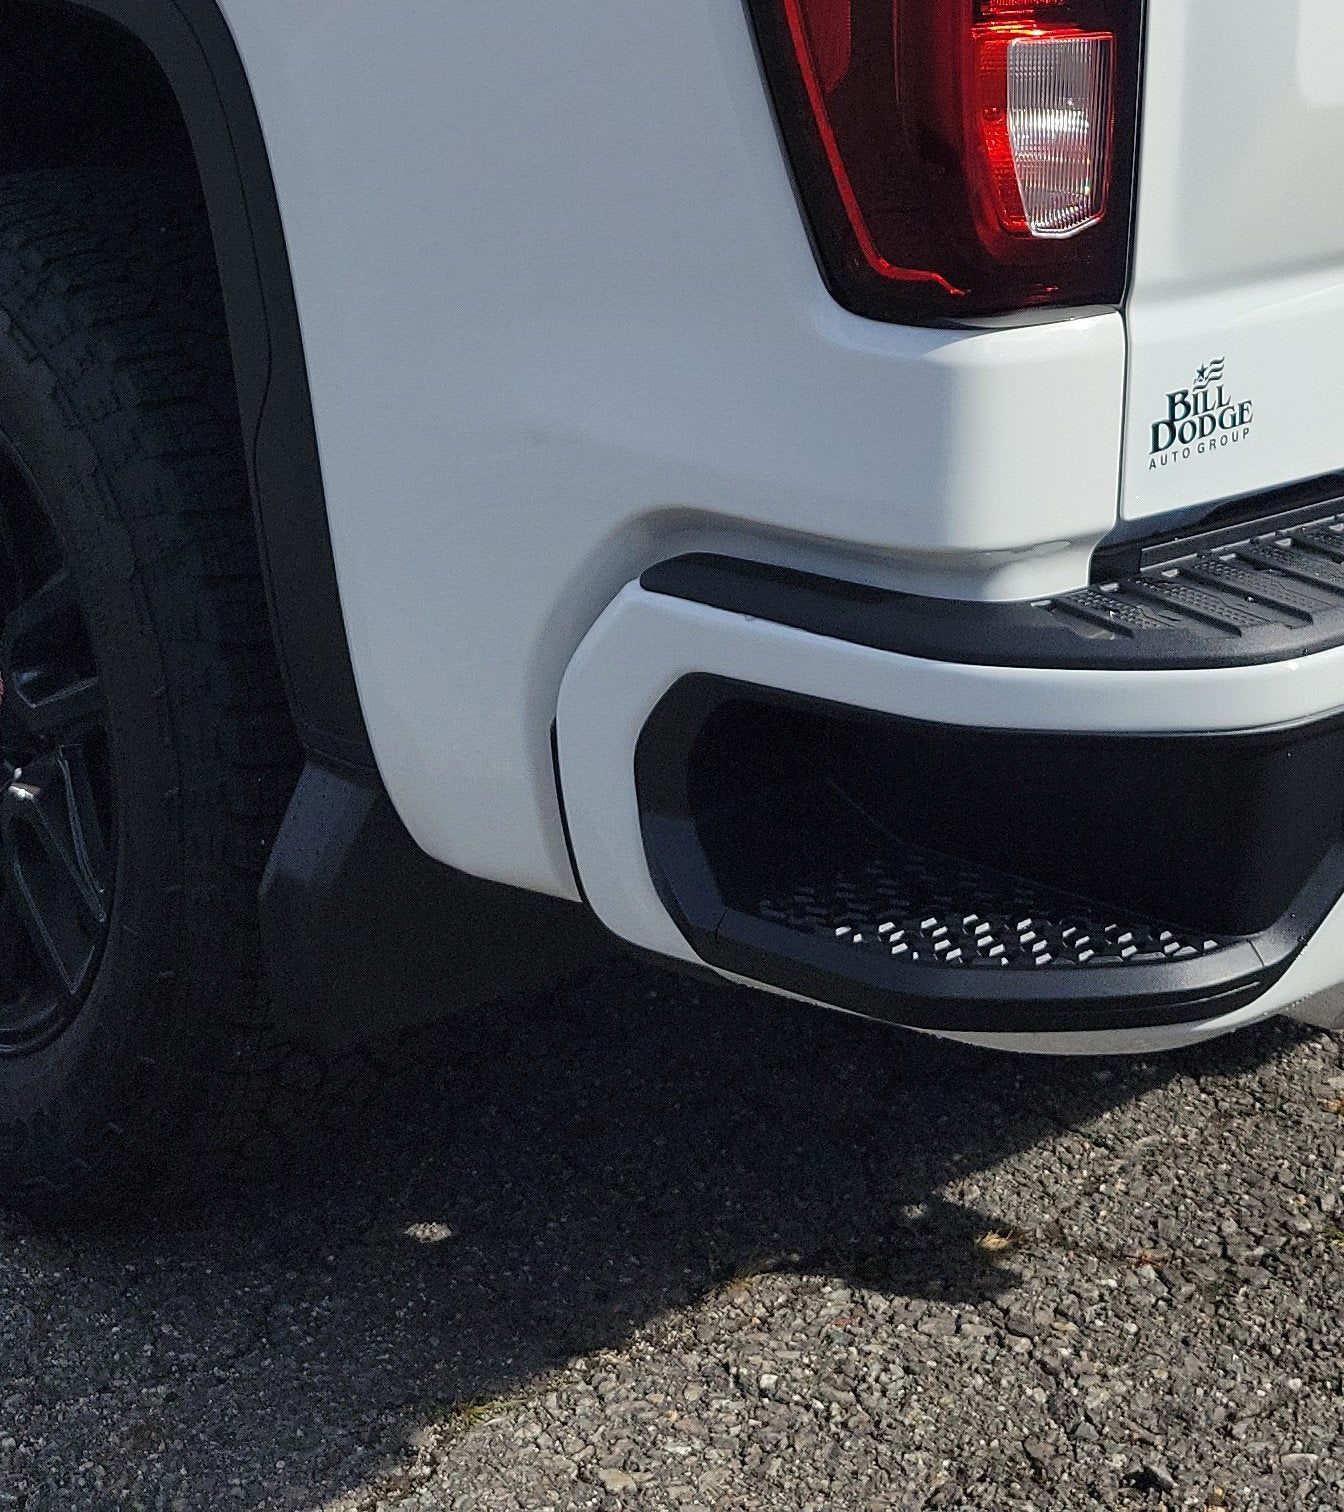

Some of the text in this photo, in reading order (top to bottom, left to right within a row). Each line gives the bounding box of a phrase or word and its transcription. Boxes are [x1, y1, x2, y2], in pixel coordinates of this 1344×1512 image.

[1166, 384, 1232, 423] BILL
[1149, 399, 1254, 455] DODGE
[1148, 428, 1250, 470] AUTO GROUP
